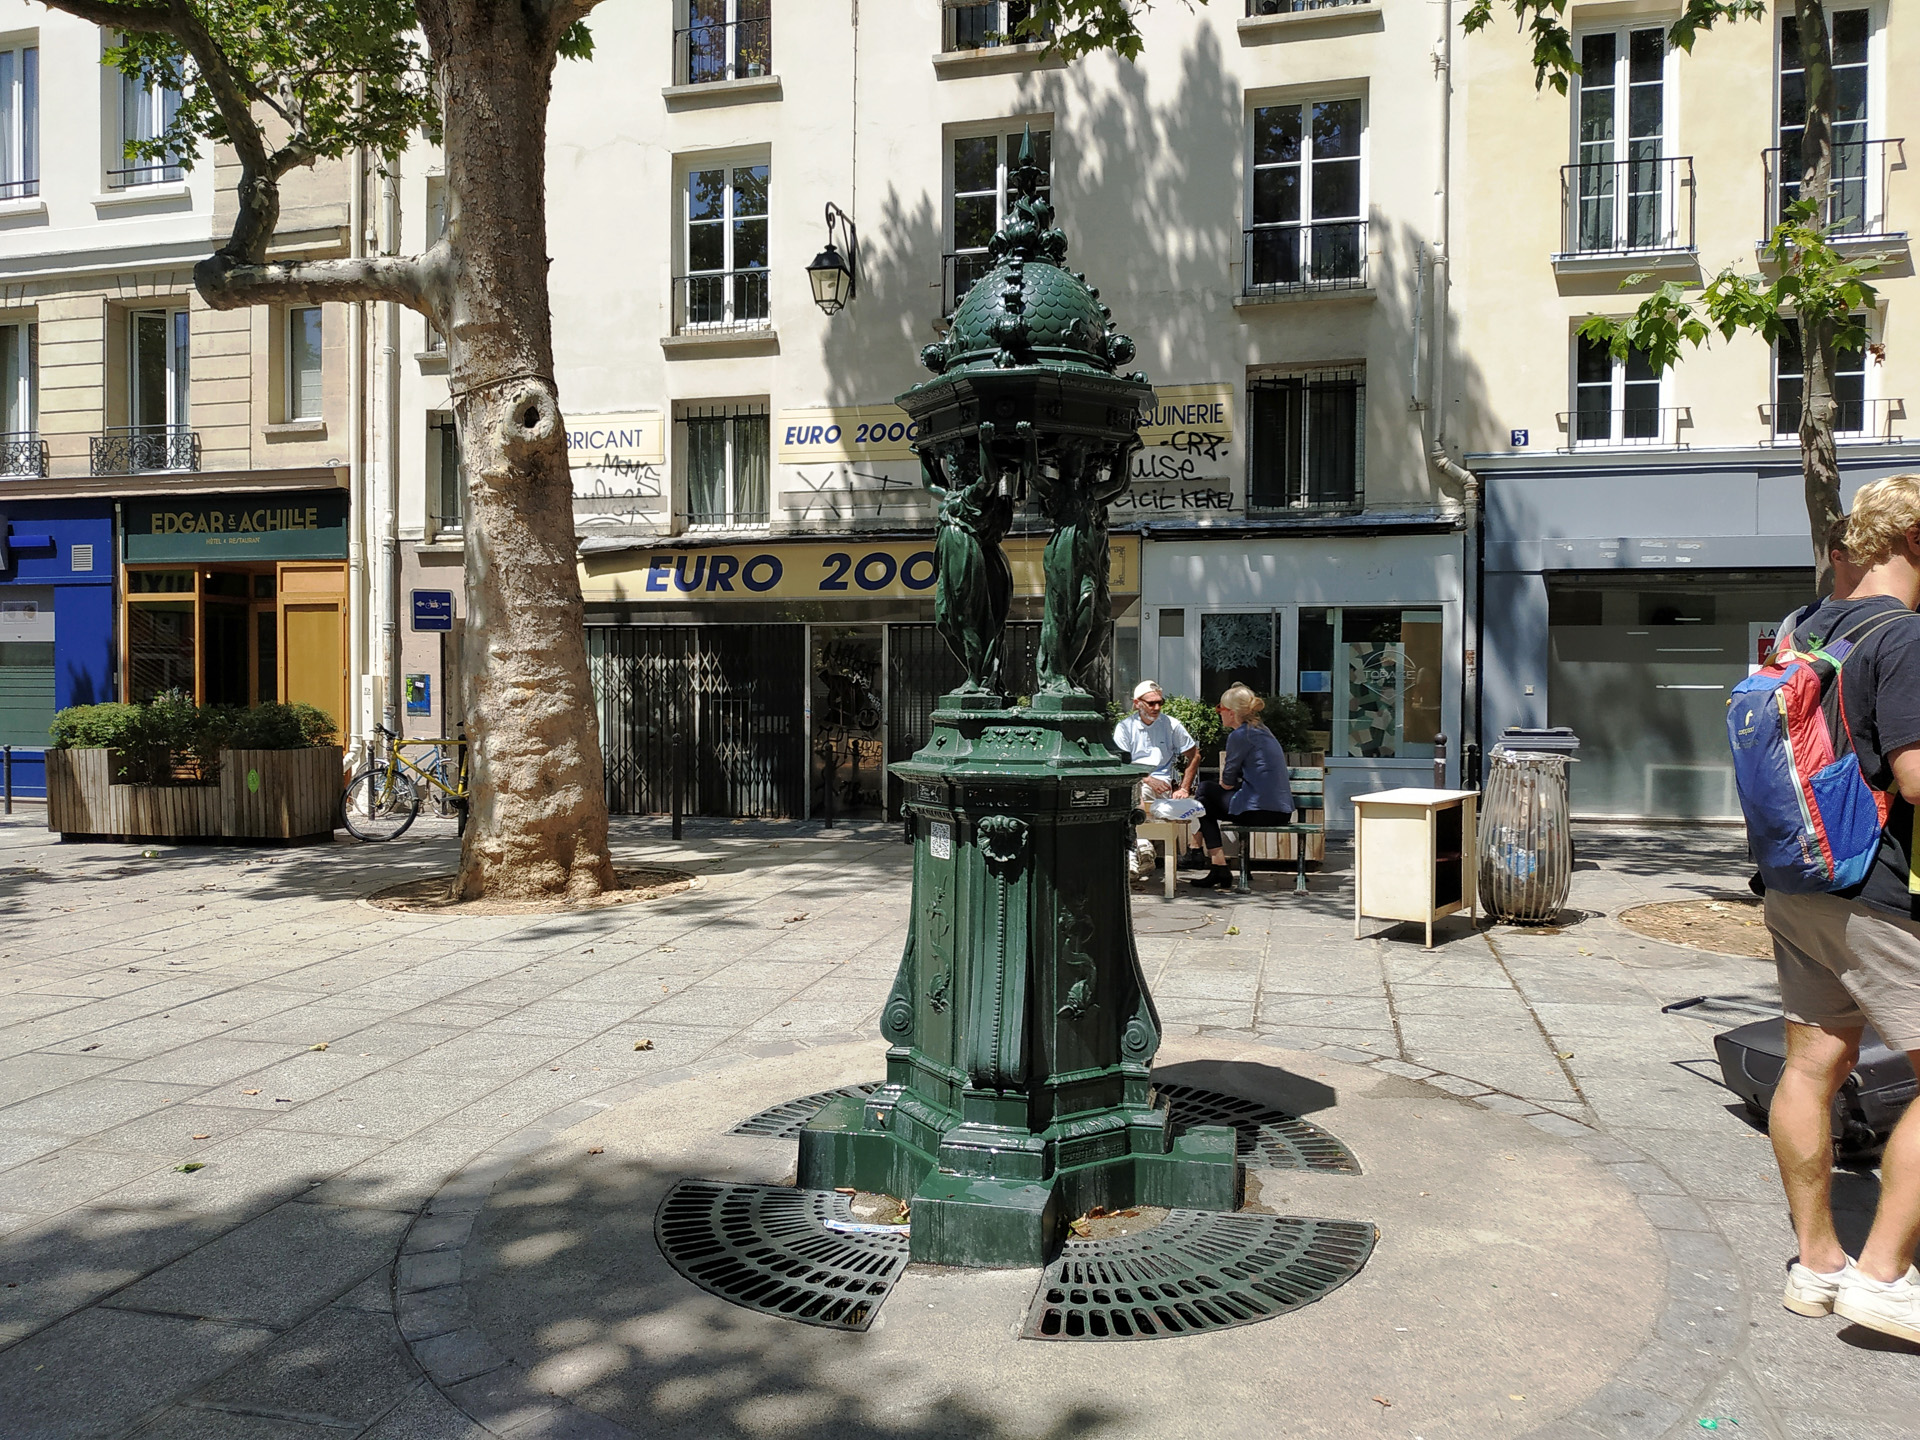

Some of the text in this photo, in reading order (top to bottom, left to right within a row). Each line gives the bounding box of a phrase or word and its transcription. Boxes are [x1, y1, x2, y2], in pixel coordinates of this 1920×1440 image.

[784, 424, 842, 446] EURO
[1514, 430, 1526, 446] 5
[151, 511, 224, 535] EDGAR
[238, 507, 318, 533] ACHILLE
[645, 554, 784, 593] EURO
[1144, 611, 1151, 621] 3
